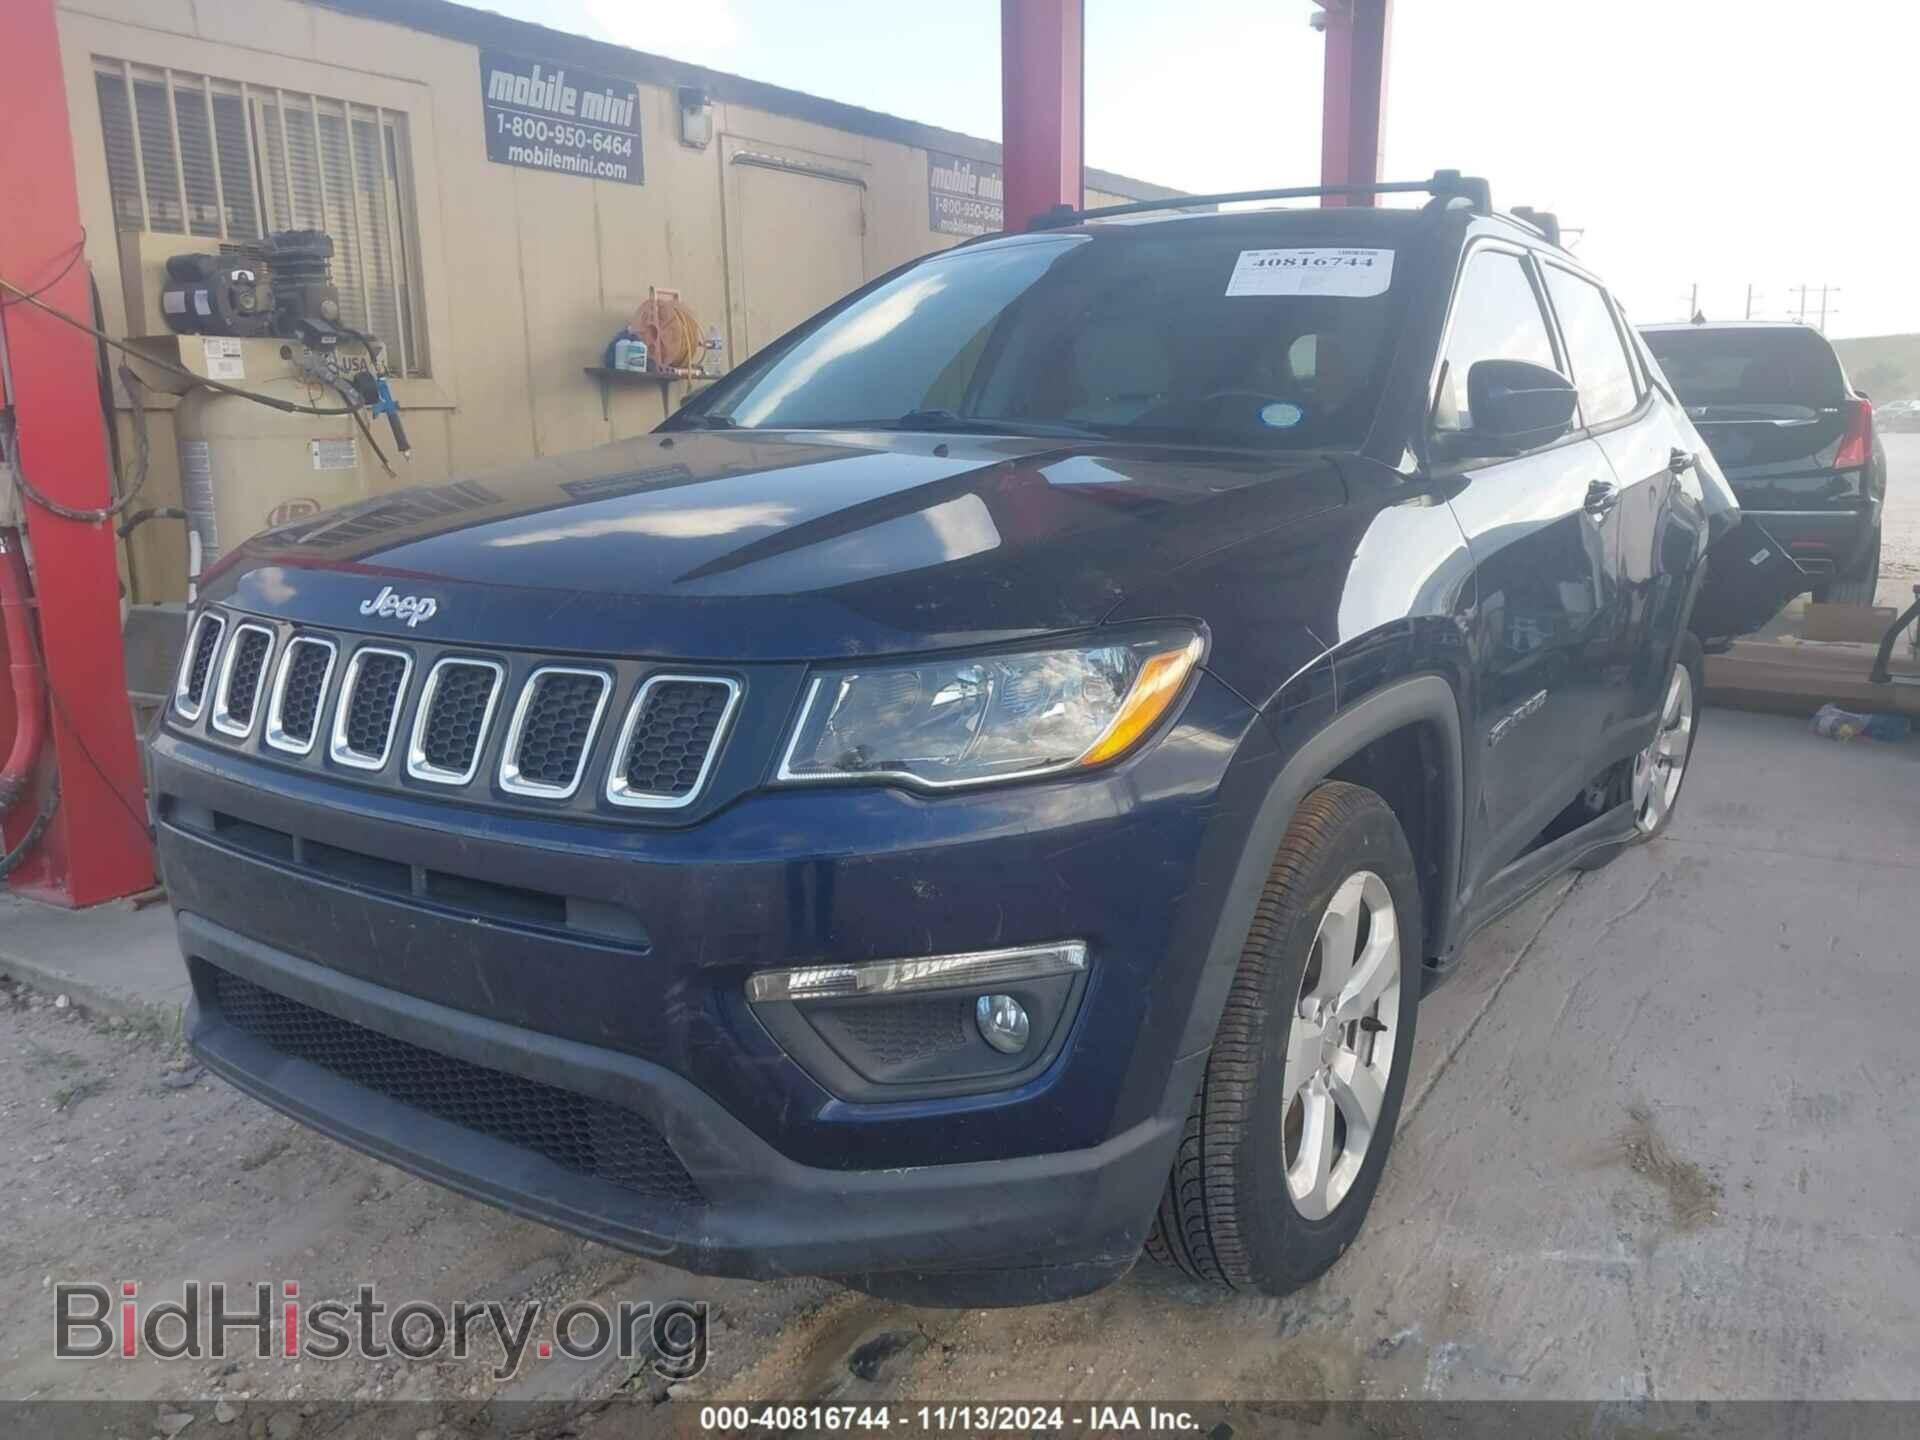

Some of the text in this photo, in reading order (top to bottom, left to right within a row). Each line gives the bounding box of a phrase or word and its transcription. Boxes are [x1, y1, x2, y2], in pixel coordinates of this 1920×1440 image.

[488, 65, 634, 127] mobile mini
[497, 113, 632, 157] 1-800-950-6464
[508, 146, 627, 179] mobilemini.com
[930, 160, 1003, 201] mobile min
[1252, 257, 1374, 267] 40816744
[342, 356, 368, 371] USA
[360, 586, 437, 628] Jeep
